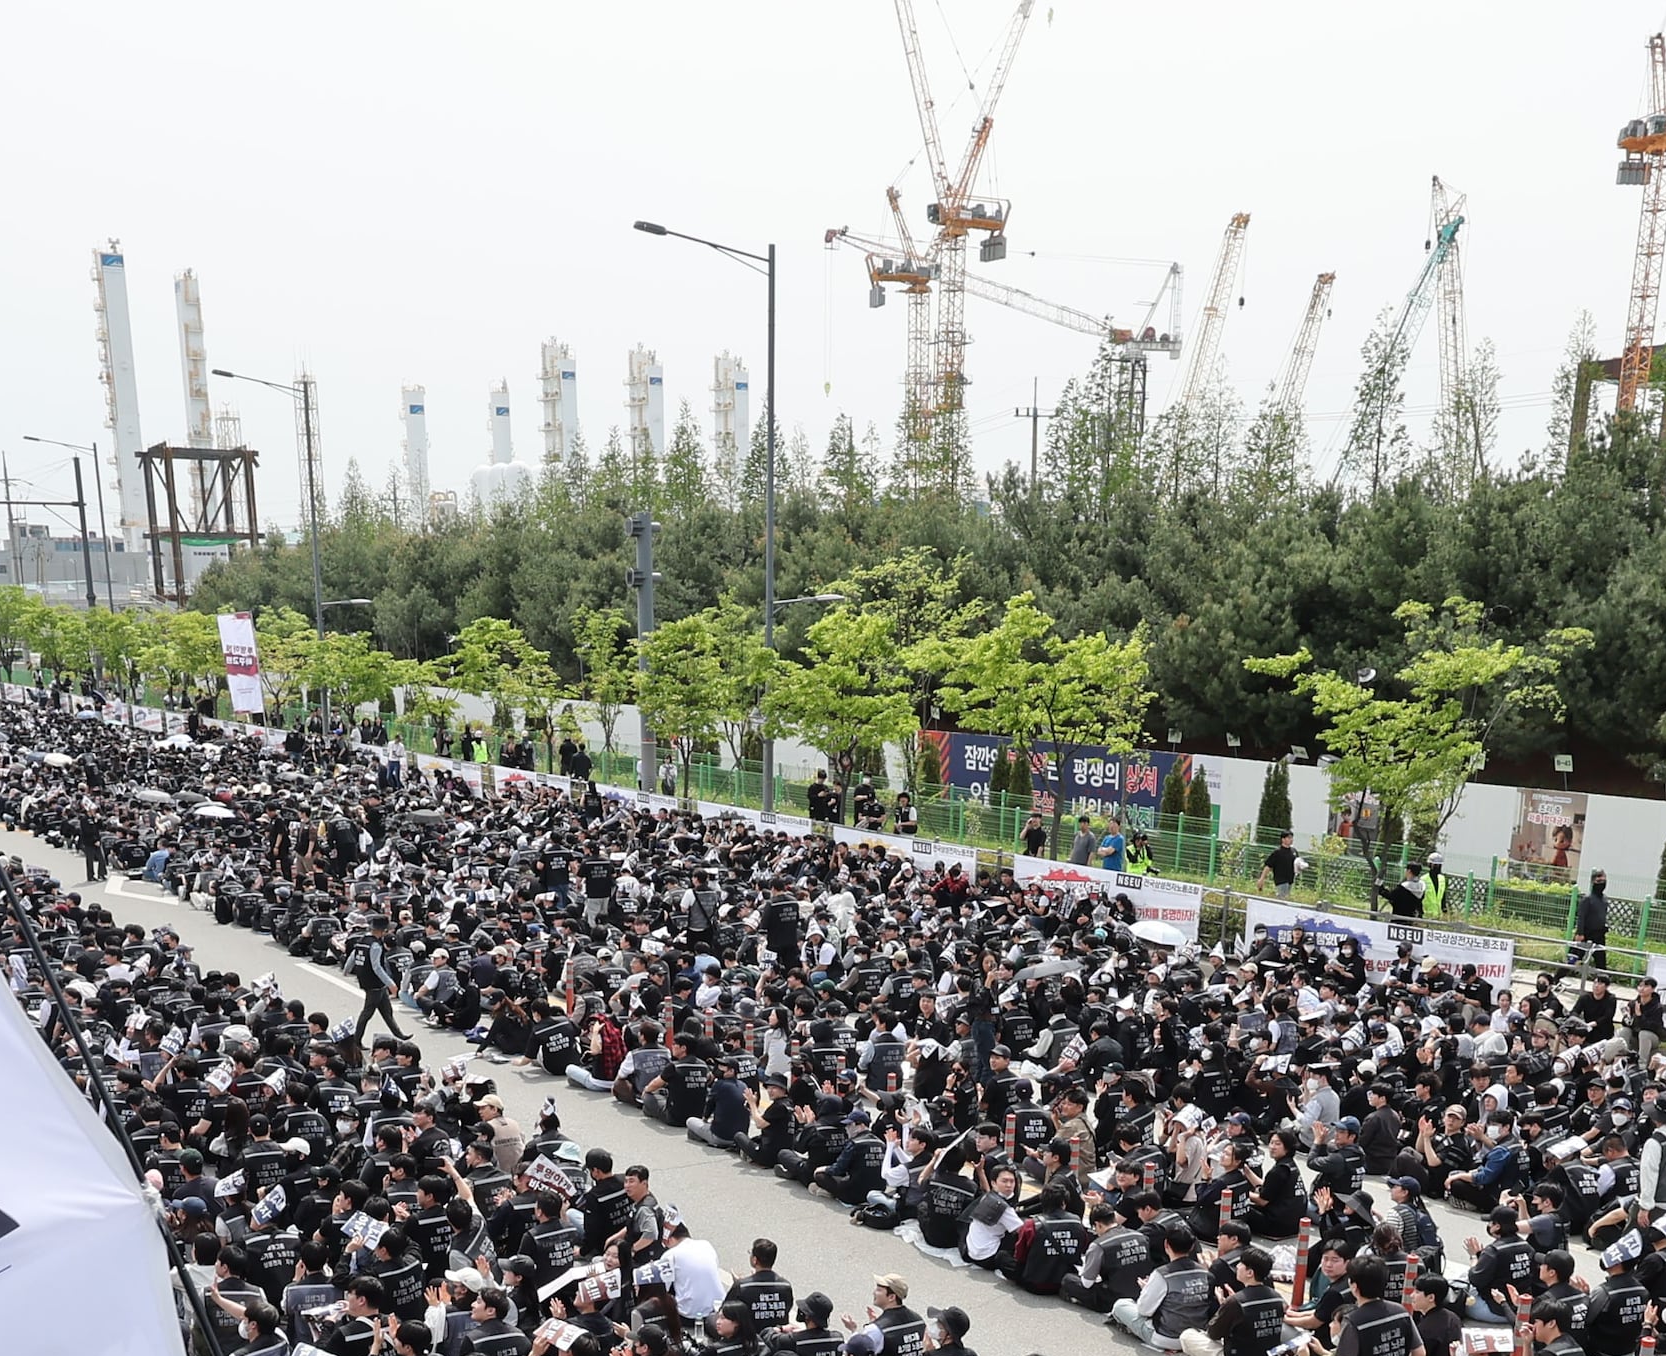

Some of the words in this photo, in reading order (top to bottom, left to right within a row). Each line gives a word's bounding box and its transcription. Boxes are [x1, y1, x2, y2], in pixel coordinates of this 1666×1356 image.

[1073, 757, 1121, 791] 평생의
[1125, 764, 1158, 798] 상처
[1117, 875, 1141, 890] NSEU
[1389, 928, 1422, 943] NSEU
[1426, 931, 1508, 951] 전국삼성전자노동조합
